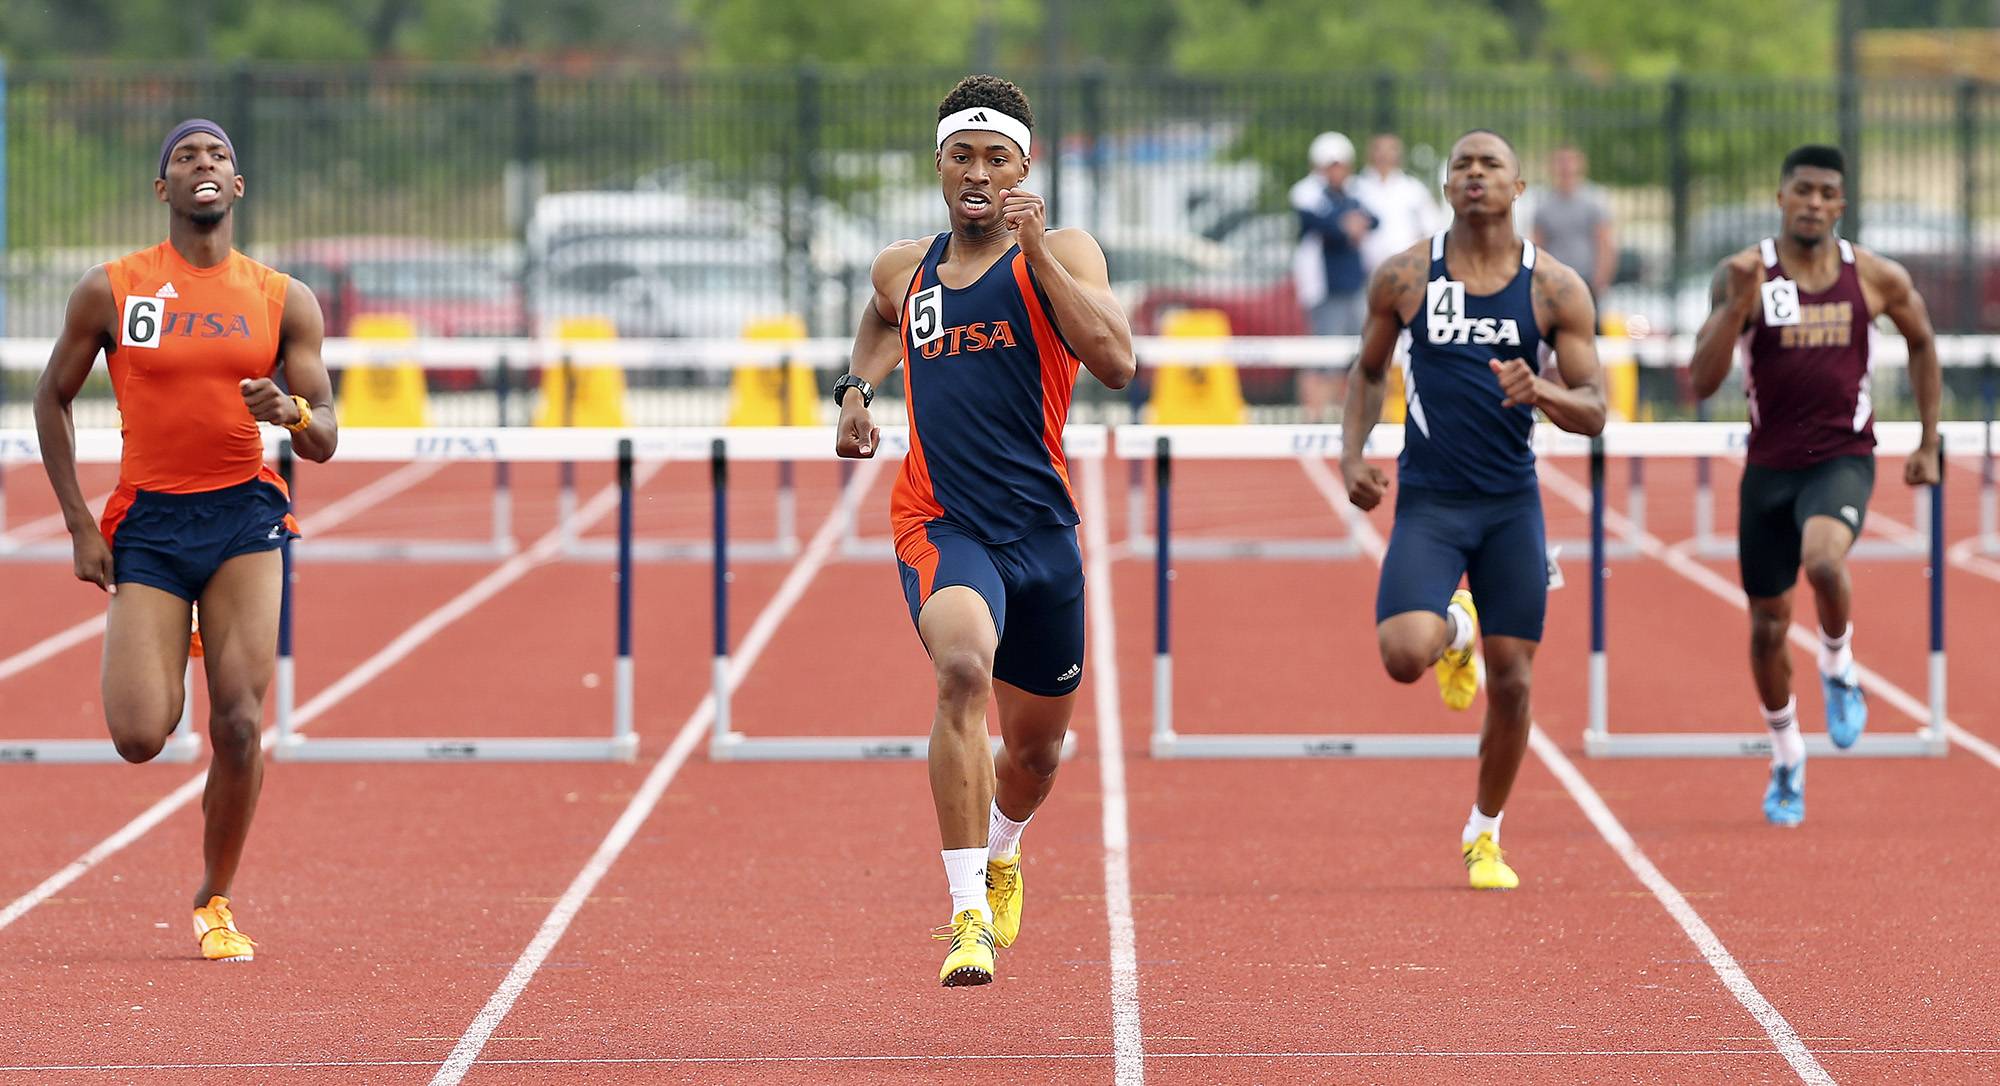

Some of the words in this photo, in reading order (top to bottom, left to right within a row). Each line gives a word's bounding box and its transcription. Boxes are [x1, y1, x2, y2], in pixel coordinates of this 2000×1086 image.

[128, 301, 156, 343] 6
[915, 291, 936, 339] 5
[1434, 287, 1456, 323] 4
[415, 437, 498, 455] UTSA
